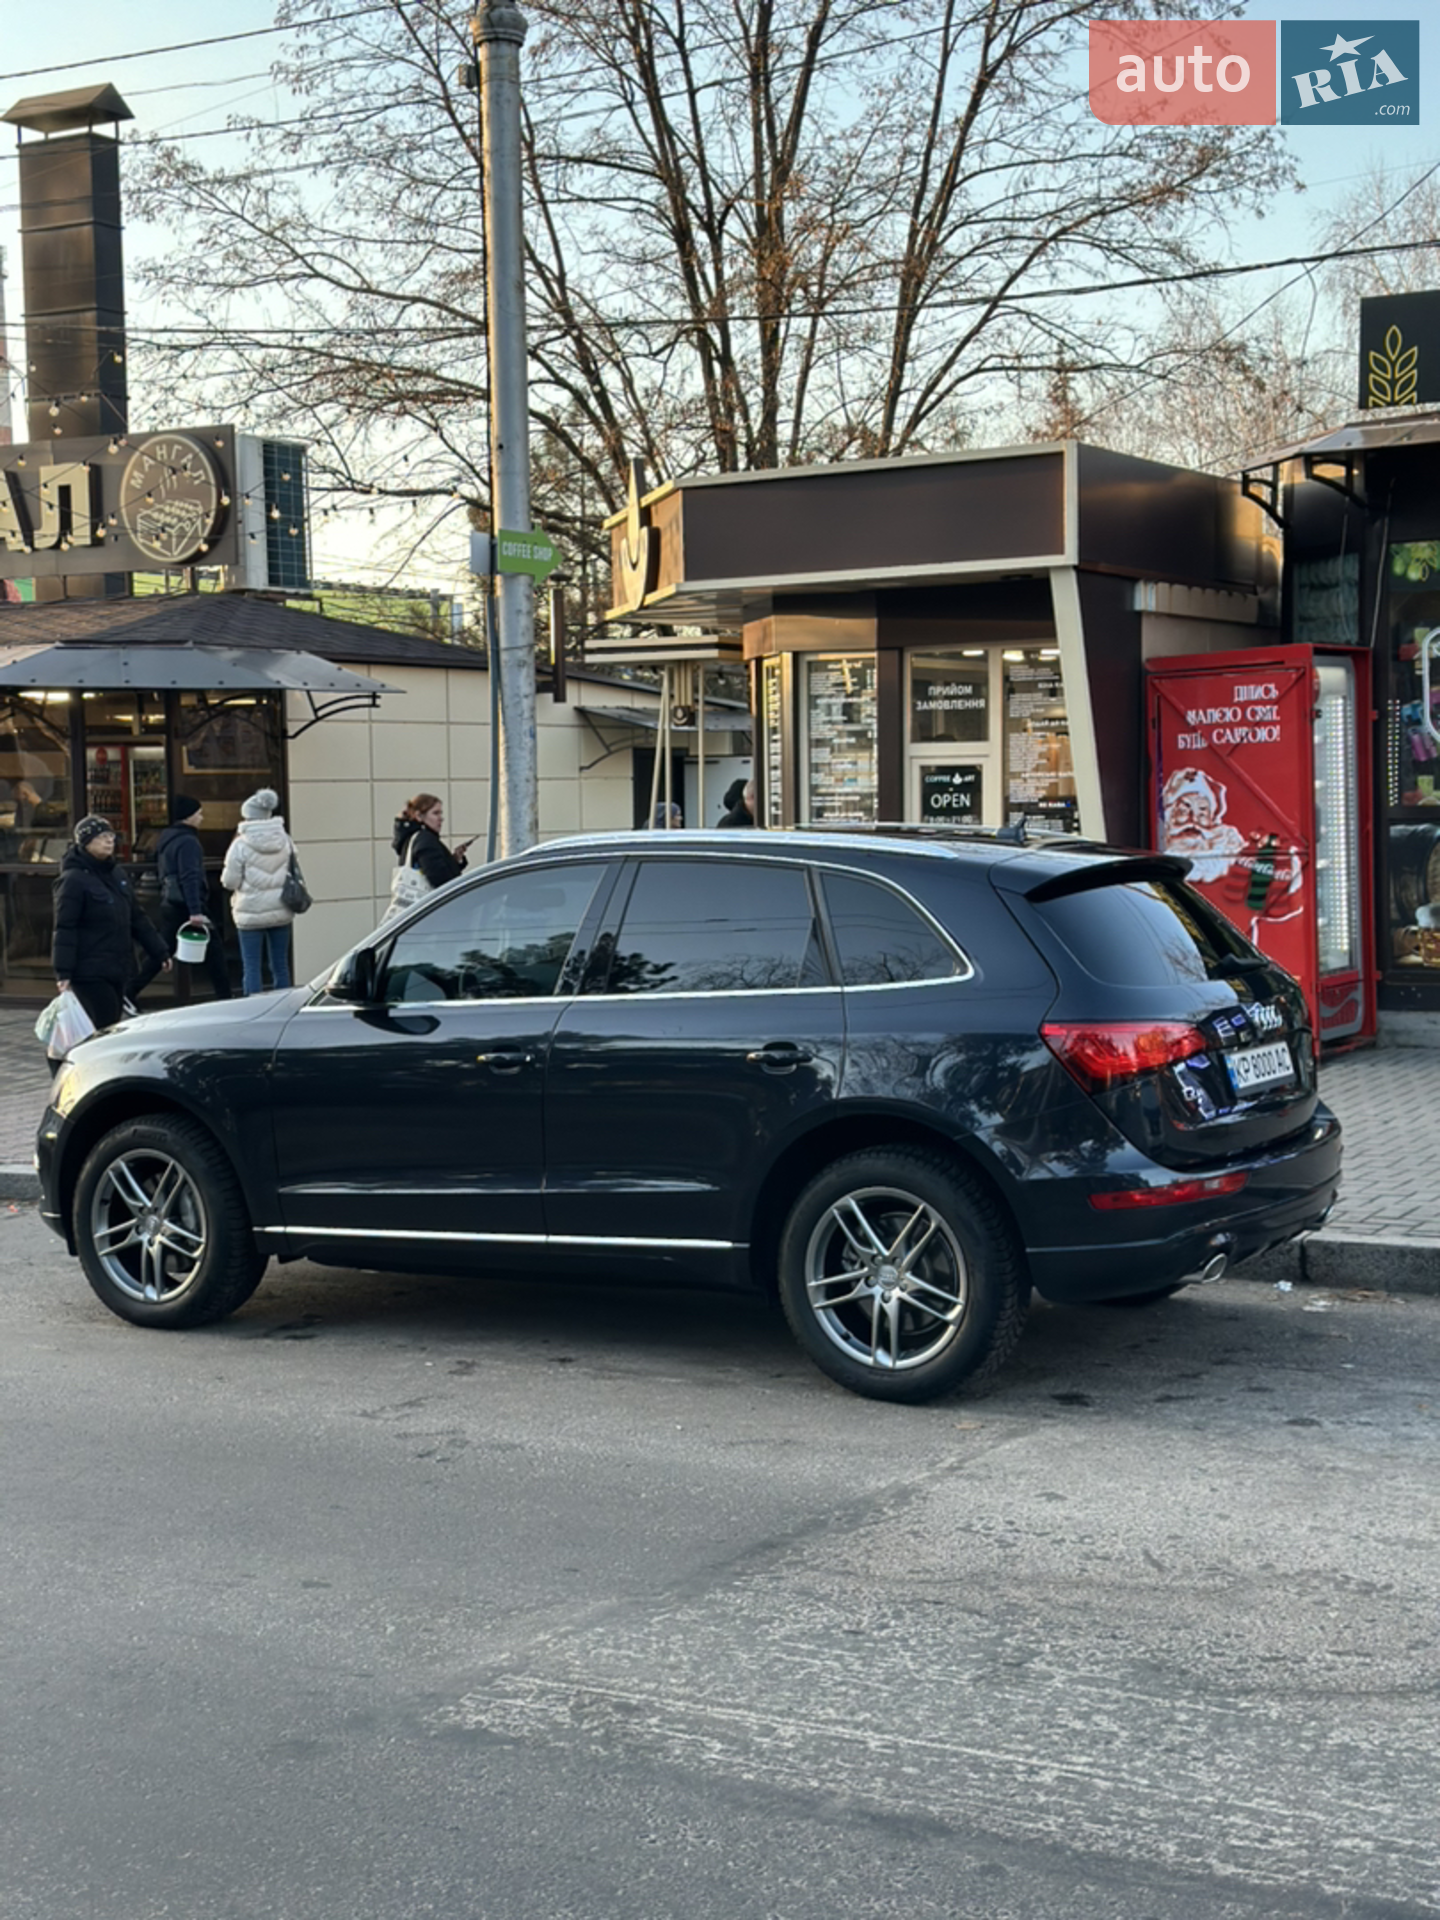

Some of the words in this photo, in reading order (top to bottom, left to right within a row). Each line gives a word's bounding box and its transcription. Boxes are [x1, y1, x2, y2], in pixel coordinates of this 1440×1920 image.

[130, 443, 206, 490] МАНГАЛ
[502, 541, 531, 558] COFFEE
[533, 545, 553, 562] SHOP
[928, 682, 973, 696] ПРИЙОМ
[915, 698, 986, 711] ЗАМОВЛЕННЯ
[924, 774, 951, 783] COFFEE
[930, 792, 971, 809] OPEN
